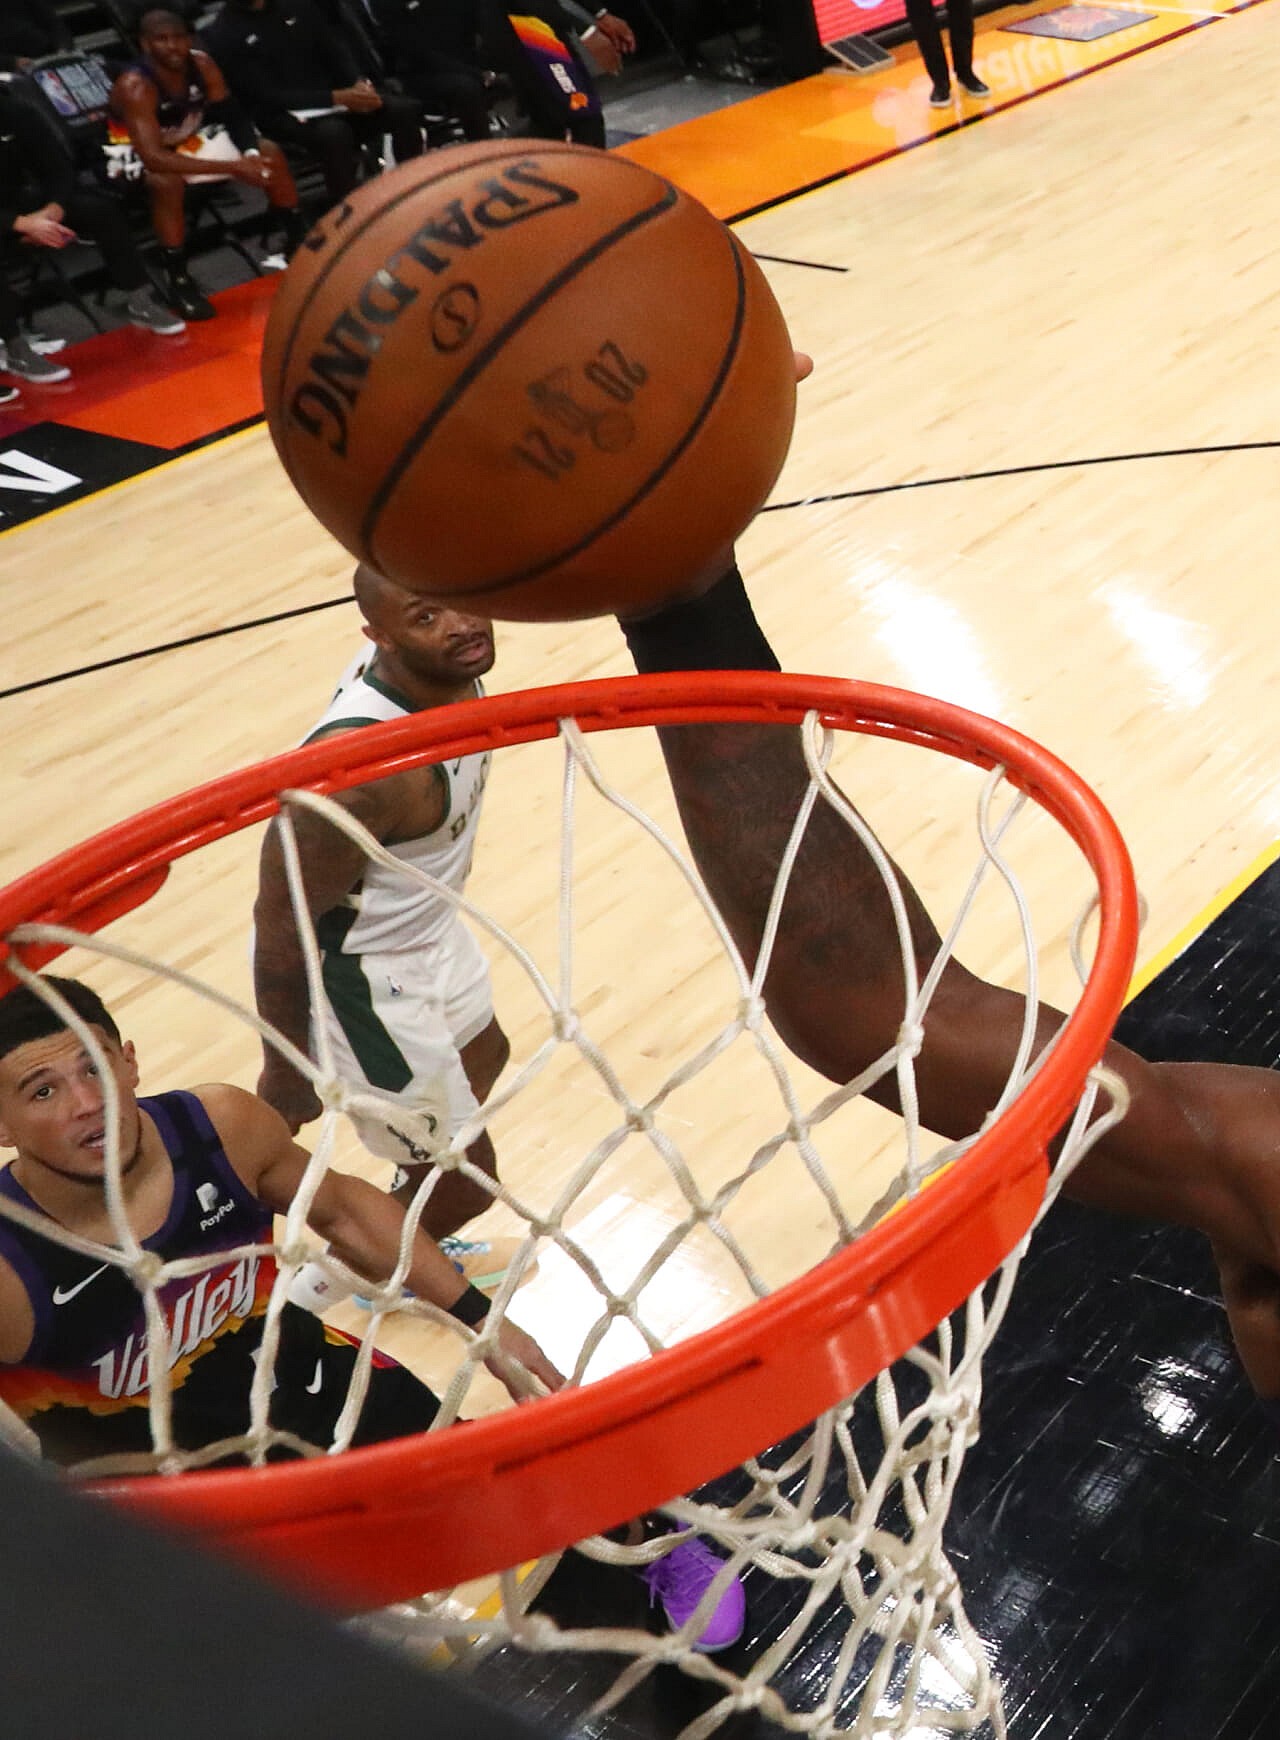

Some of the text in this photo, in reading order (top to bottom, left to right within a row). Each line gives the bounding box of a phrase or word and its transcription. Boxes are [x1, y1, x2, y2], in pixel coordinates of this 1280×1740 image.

[289, 160, 580, 457] SPALDING
[585, 341, 648, 402] 20
[200, 1200, 235, 1231] PayPal
